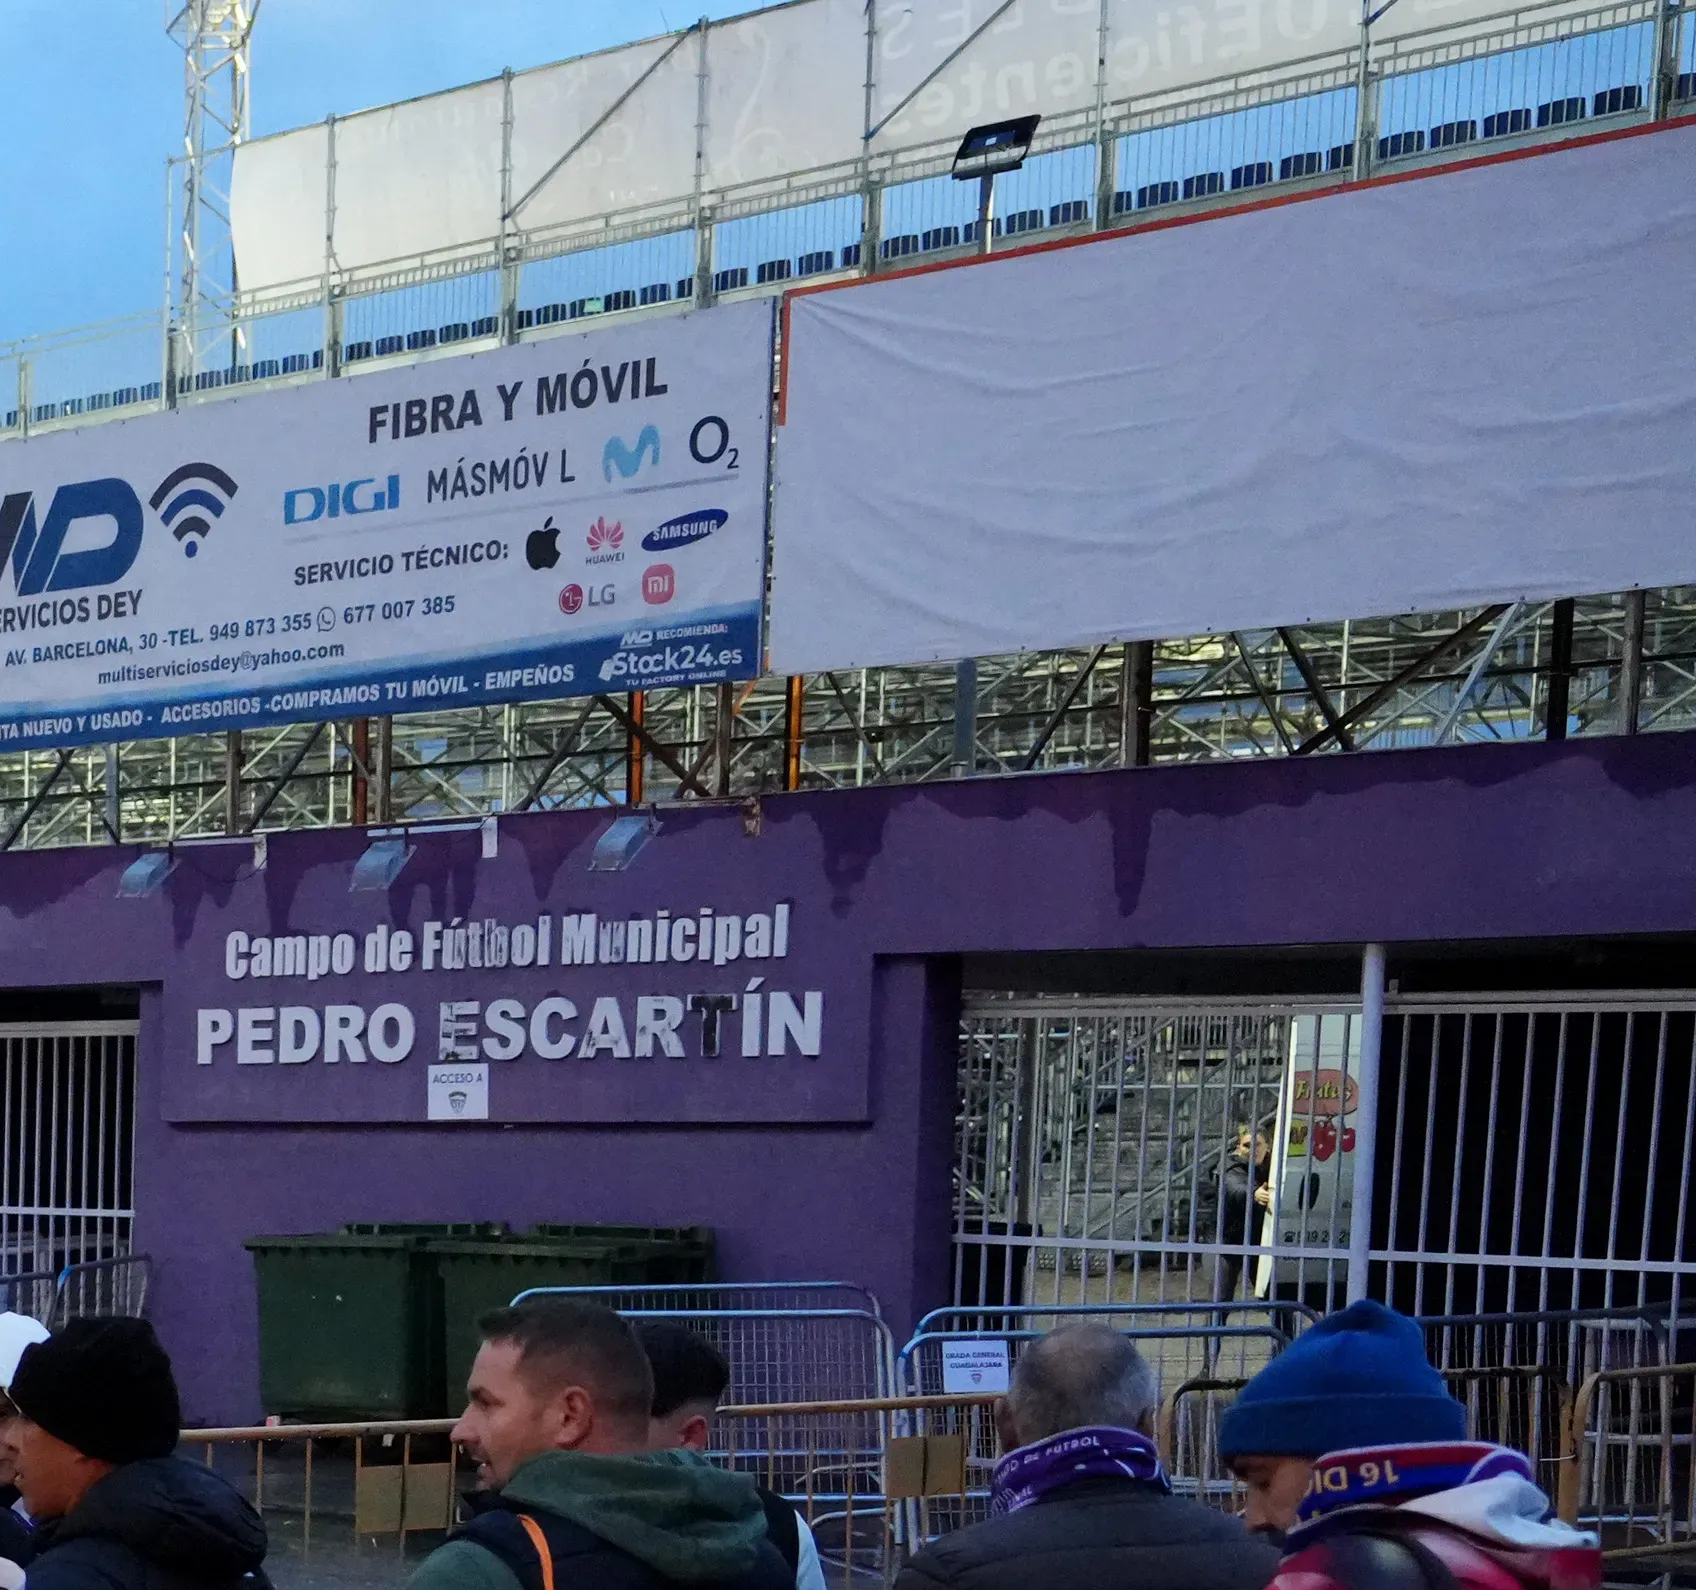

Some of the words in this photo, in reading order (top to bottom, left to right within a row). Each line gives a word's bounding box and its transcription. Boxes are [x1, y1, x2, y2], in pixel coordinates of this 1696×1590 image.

[368, 389, 484, 444] FIBRA
[497, 380, 524, 422] Y
[536, 357, 668, 416] MÓVIL
[284, 474, 400, 525] DIGI
[652, 519, 718, 541] SAMSUNG
[294, 554, 394, 586] SERVICIO
[405, 539, 508, 572] TÉCNICO:
[585, 552, 625, 565] HUAWEI
[97, 588, 143, 621] DEY
[588, 583, 616, 607] LG
[5, 649, 28, 667] AV.
[33, 638, 134, 663] BARCELONA,
[139, 633, 157, 651] 30
[210, 622, 239, 641] 949
[245, 618, 275, 637] 873
[282, 613, 312, 632] 355
[344, 605, 375, 625] 677
[382, 600, 414, 621] 007
[421, 595, 456, 616] 385
[656, 624, 728, 641] RECOMIENDA:
[98, 642, 345, 686] multiserviciosdey@yahoo.com
[612, 643, 743, 677] Stock24.es
[23, 717, 72, 738] NUEVO
[76, 715, 86, 733] Y
[91, 709, 143, 732] USADO
[161, 697, 261, 724] ACCESORIOS
[385, 681, 408, 700] TU
[412, 673, 469, 698] MÓVIL
[485, 662, 575, 691] EMPEÑOS
[225, 931, 356, 981] Campo
[364, 924, 414, 973] de
[422, 916, 550, 970] Fútbol
[560, 904, 790, 967] Municipal
[196, 1002, 416, 1065] PEDRO
[438, 977, 823, 1062] ESCARTÍN
[432, 1073, 474, 1084] ACCESO
[476, 1073, 483, 1083] A
[950, 1361, 1003, 1369] GUADALAJARA
[972, 1351, 1005, 1359] GENERAL
[1359, 1460, 1400, 1486] 16
